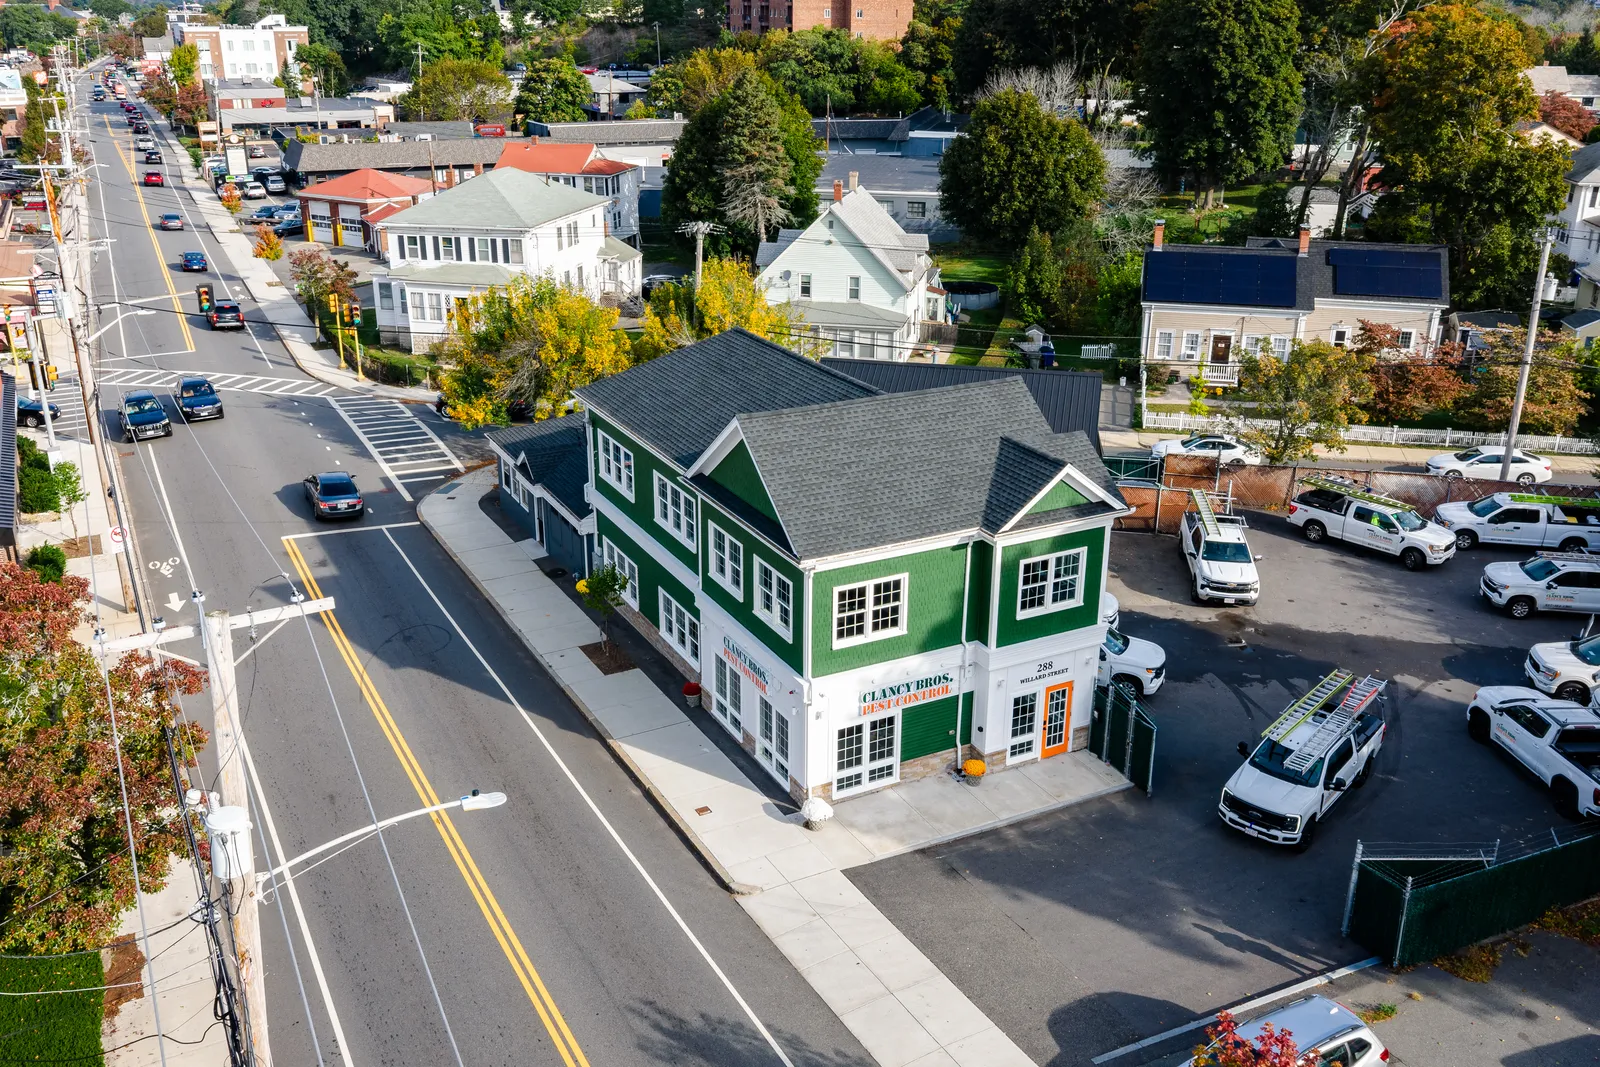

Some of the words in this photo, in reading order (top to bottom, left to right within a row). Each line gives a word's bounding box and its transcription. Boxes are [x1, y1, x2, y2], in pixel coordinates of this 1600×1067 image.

[723, 647, 738, 667] PEST
[739, 661, 768, 695] CONTROL
[724, 636, 748, 664] CLANCY
[749, 658, 768, 685] BROS.
[1019, 673, 1047, 684] WILLARD
[1047, 667, 1069, 678] STREET
[1037, 660, 1053, 673] 288
[862, 681, 913, 704] CLANCY
[916, 672, 954, 690] BROS.
[862, 698, 894, 716] PEST
[895, 684, 952, 707] CONTROL
